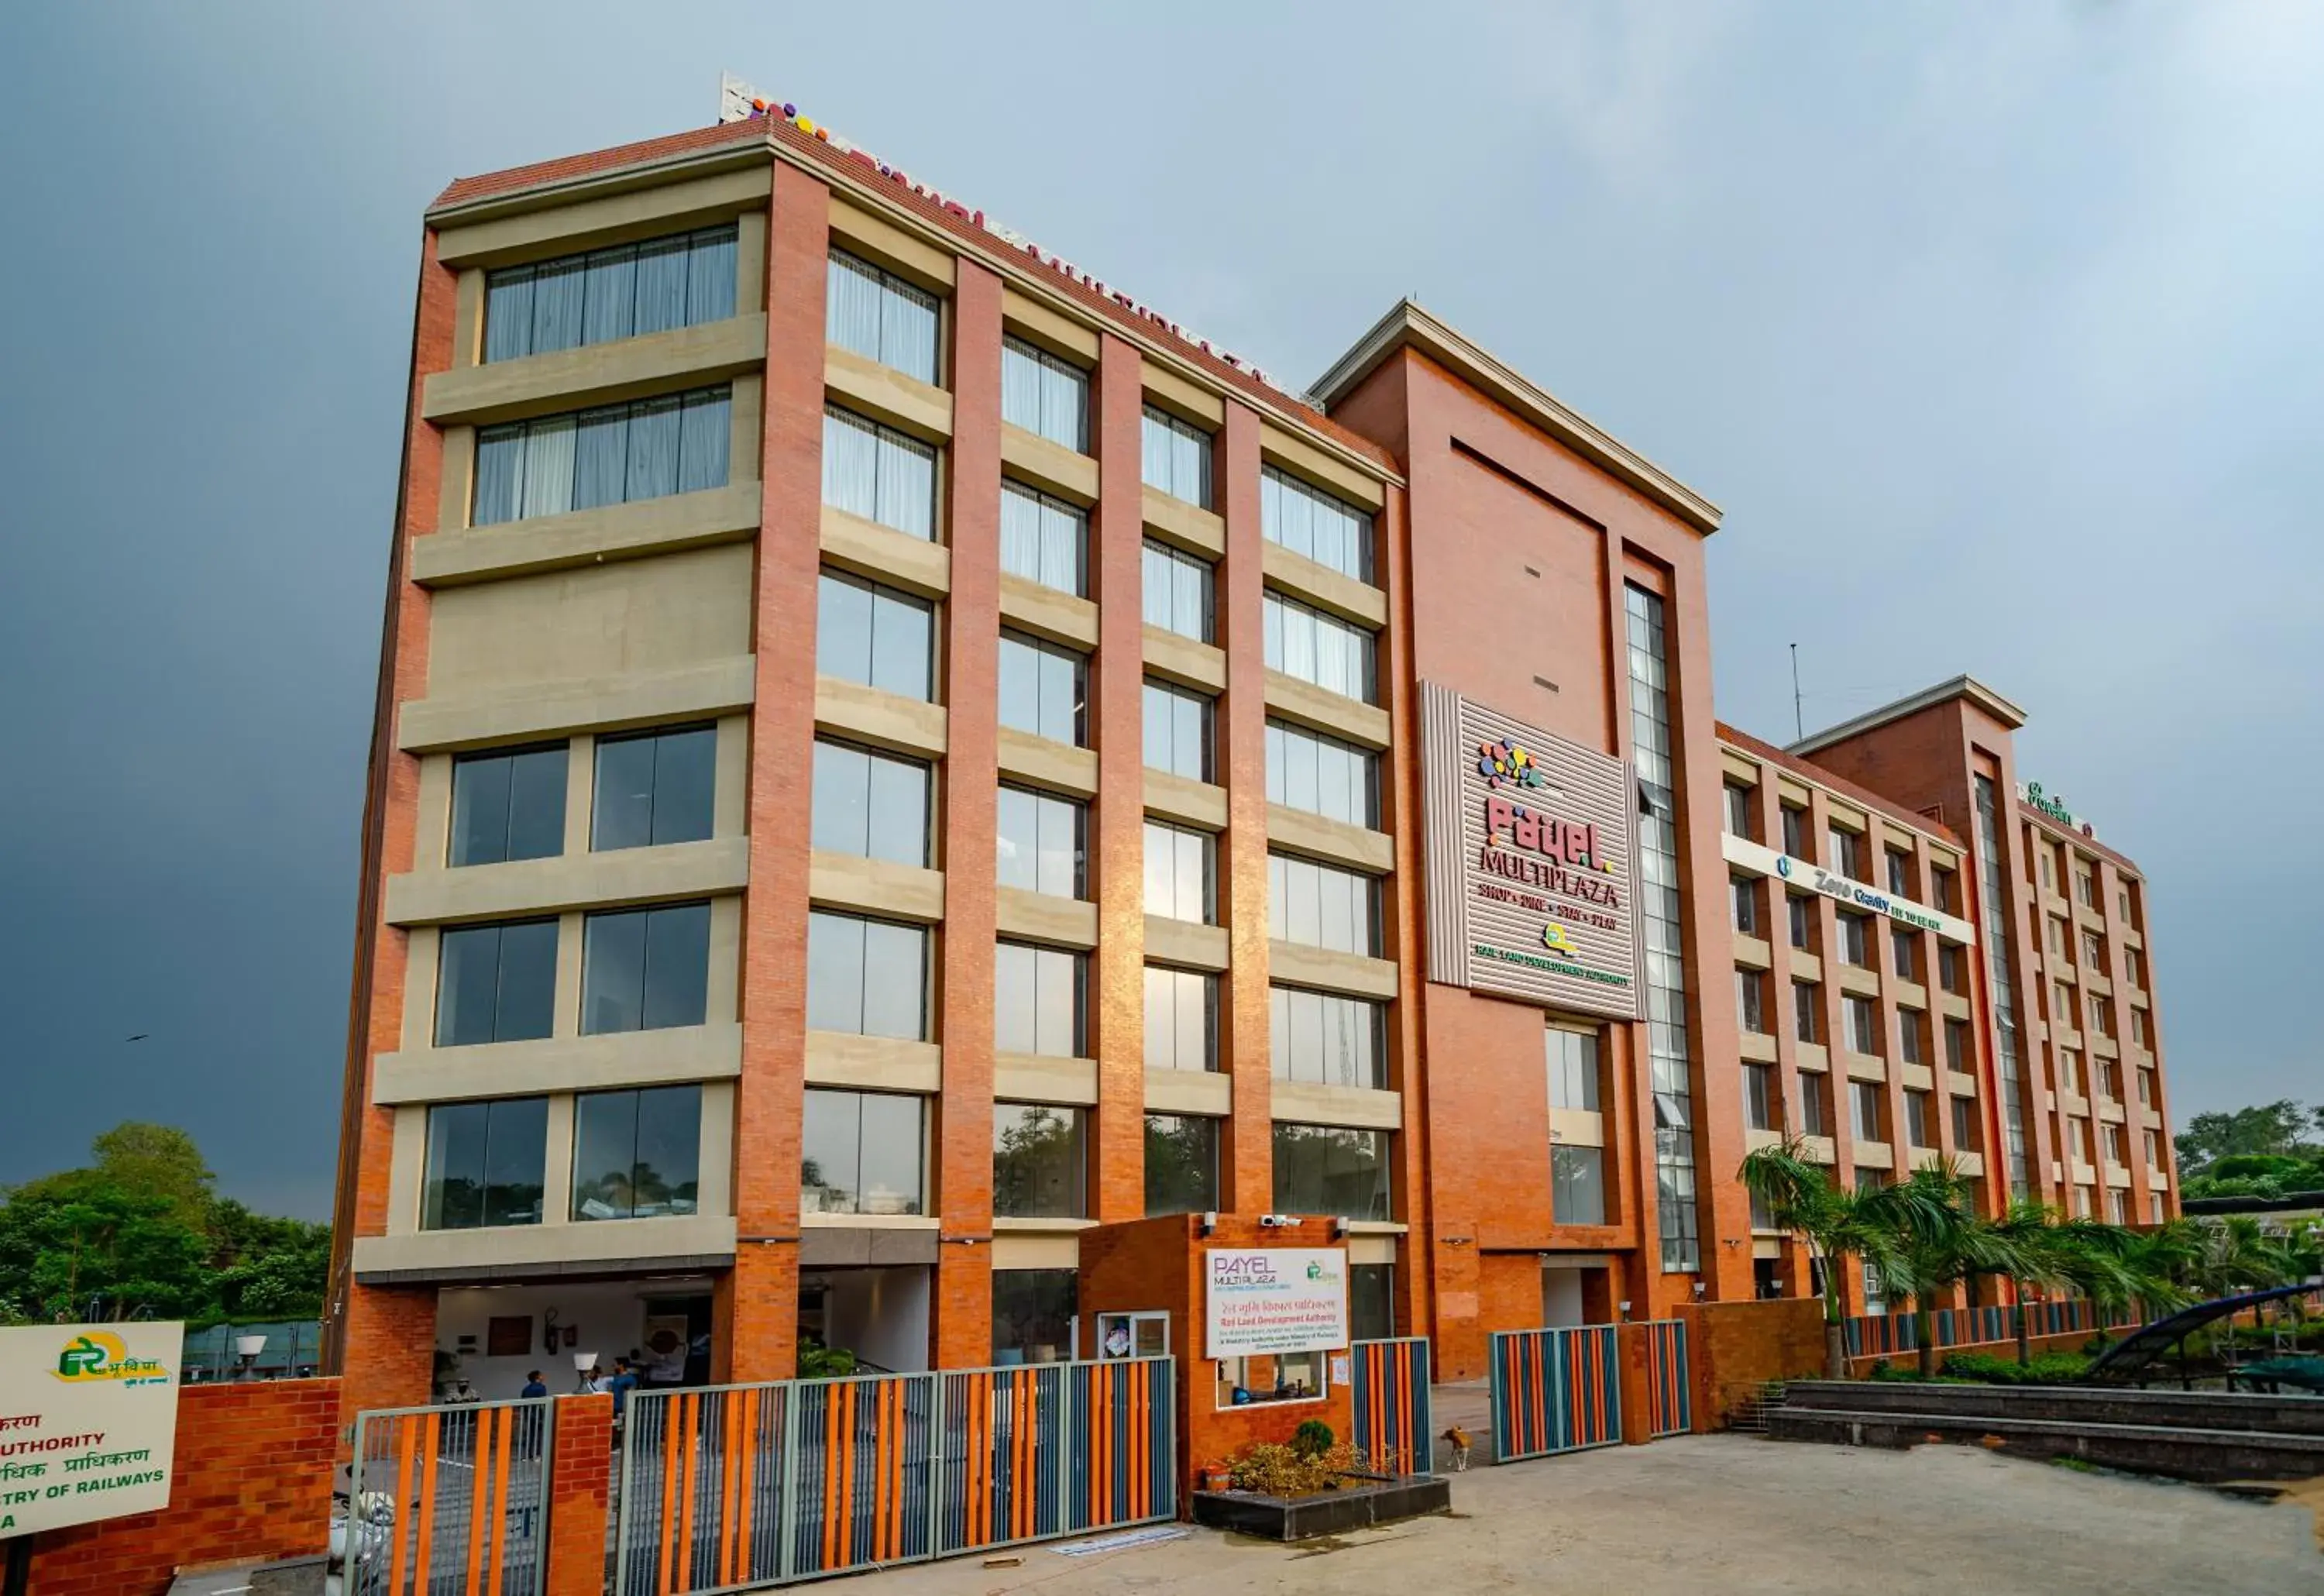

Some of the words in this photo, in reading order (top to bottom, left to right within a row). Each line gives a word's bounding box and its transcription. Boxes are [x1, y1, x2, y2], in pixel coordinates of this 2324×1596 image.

[1478, 882, 1511, 902] SHOP
[1481, 847, 1618, 908] MULTIPLAZA
[1814, 869, 1851, 898] Zero
[1854, 889, 1889, 913] Gravity
[1214, 1256, 1277, 1274] PAYEL
[0, 1462, 48, 1481] धिक
[64, 1450, 150, 1472] प्राधिकरण
[0, 1488, 40, 1505] TRY
[46, 1484, 71, 1499] OF
[76, 1470, 164, 1495] RAILWAYS
